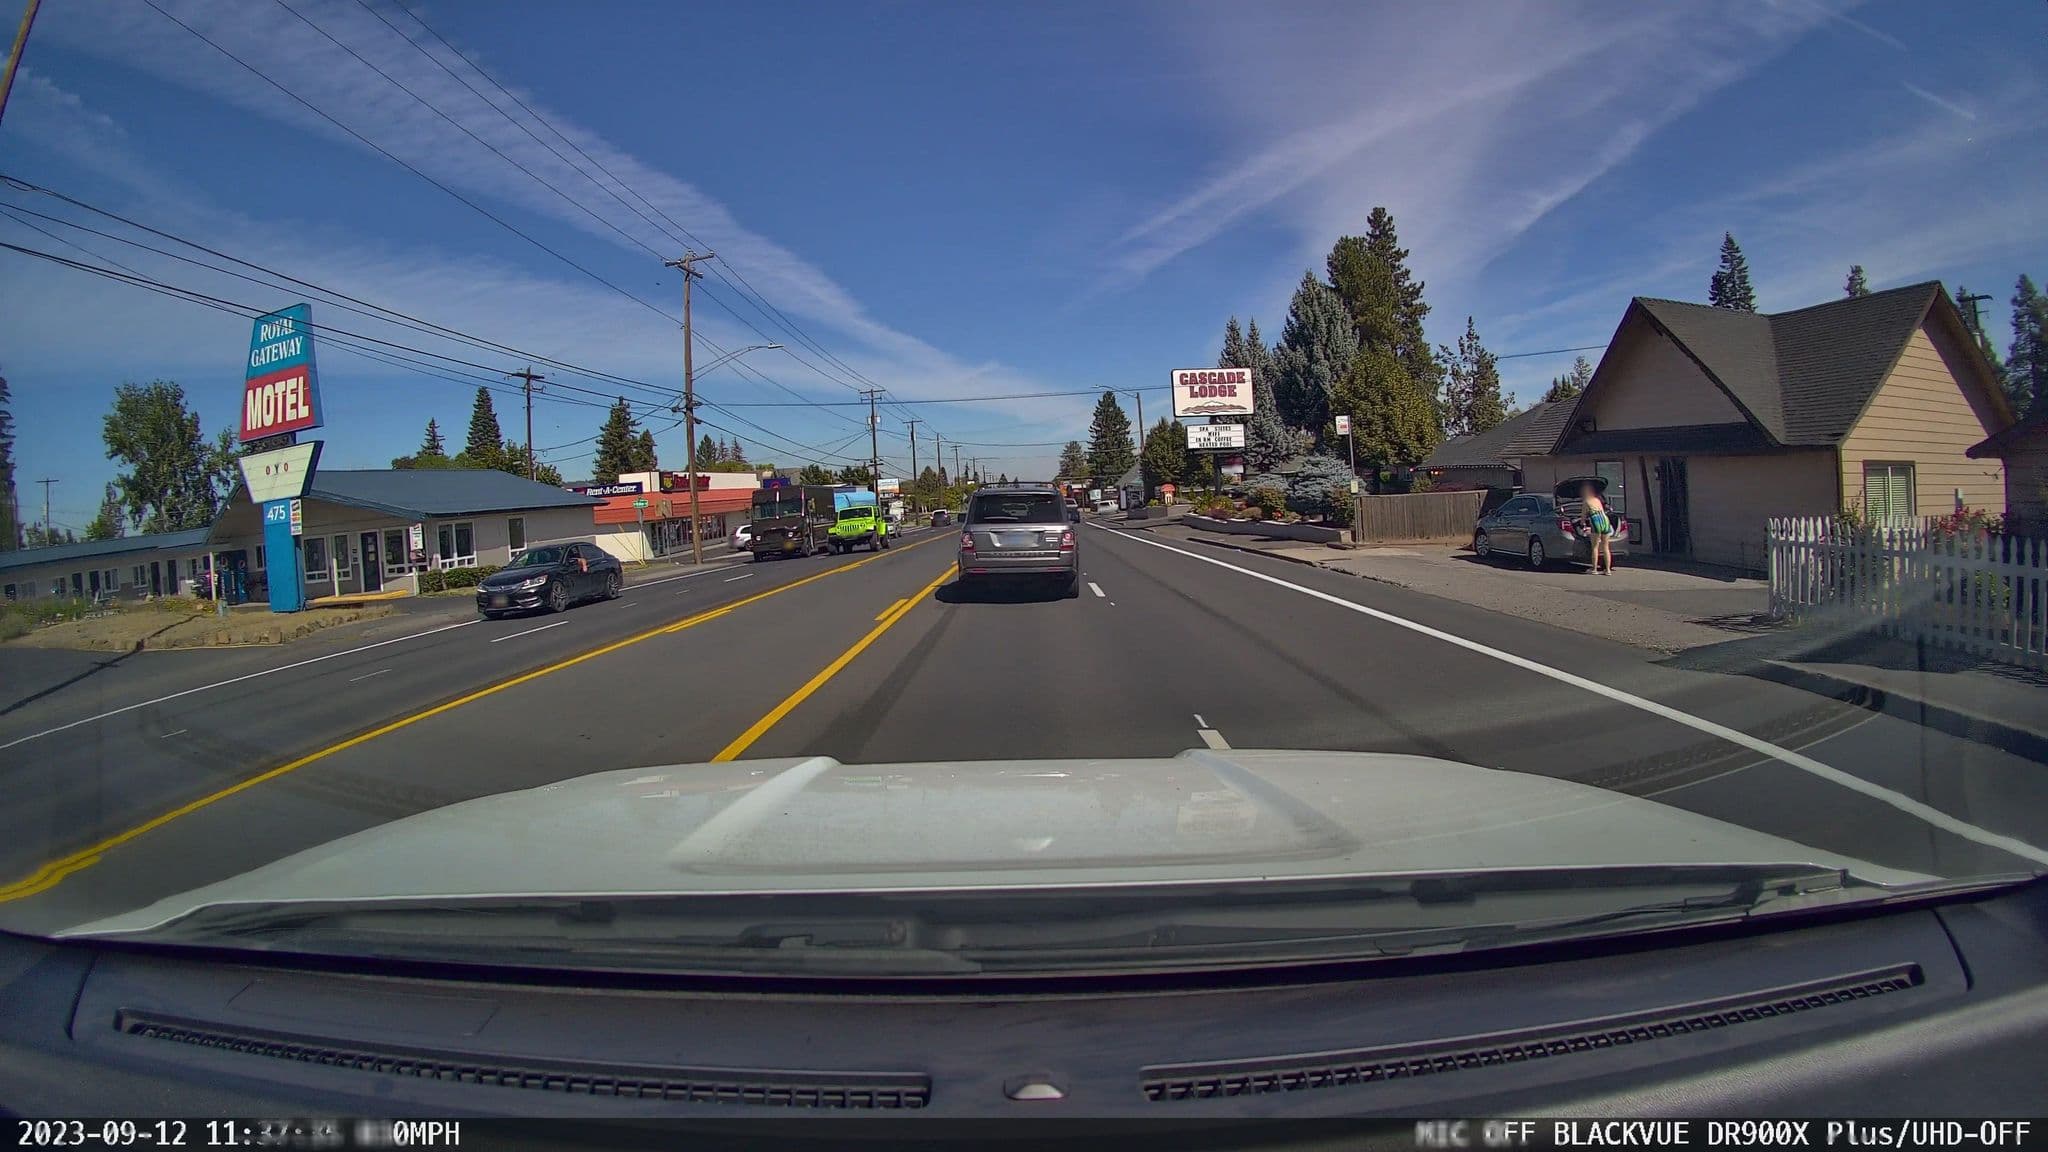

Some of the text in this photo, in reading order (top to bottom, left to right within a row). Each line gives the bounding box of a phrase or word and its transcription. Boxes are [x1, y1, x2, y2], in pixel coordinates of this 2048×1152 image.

[260, 317, 296, 343] ROYAL
[251, 336, 302, 367] GATEWAY
[1179, 372, 1245, 386] CASCADE
[1189, 385, 1237, 398] LODGE
[247, 376, 309, 431] MOTEL
[586, 485, 637, 497] Rent-A-Center
[267, 505, 286, 521] 475
